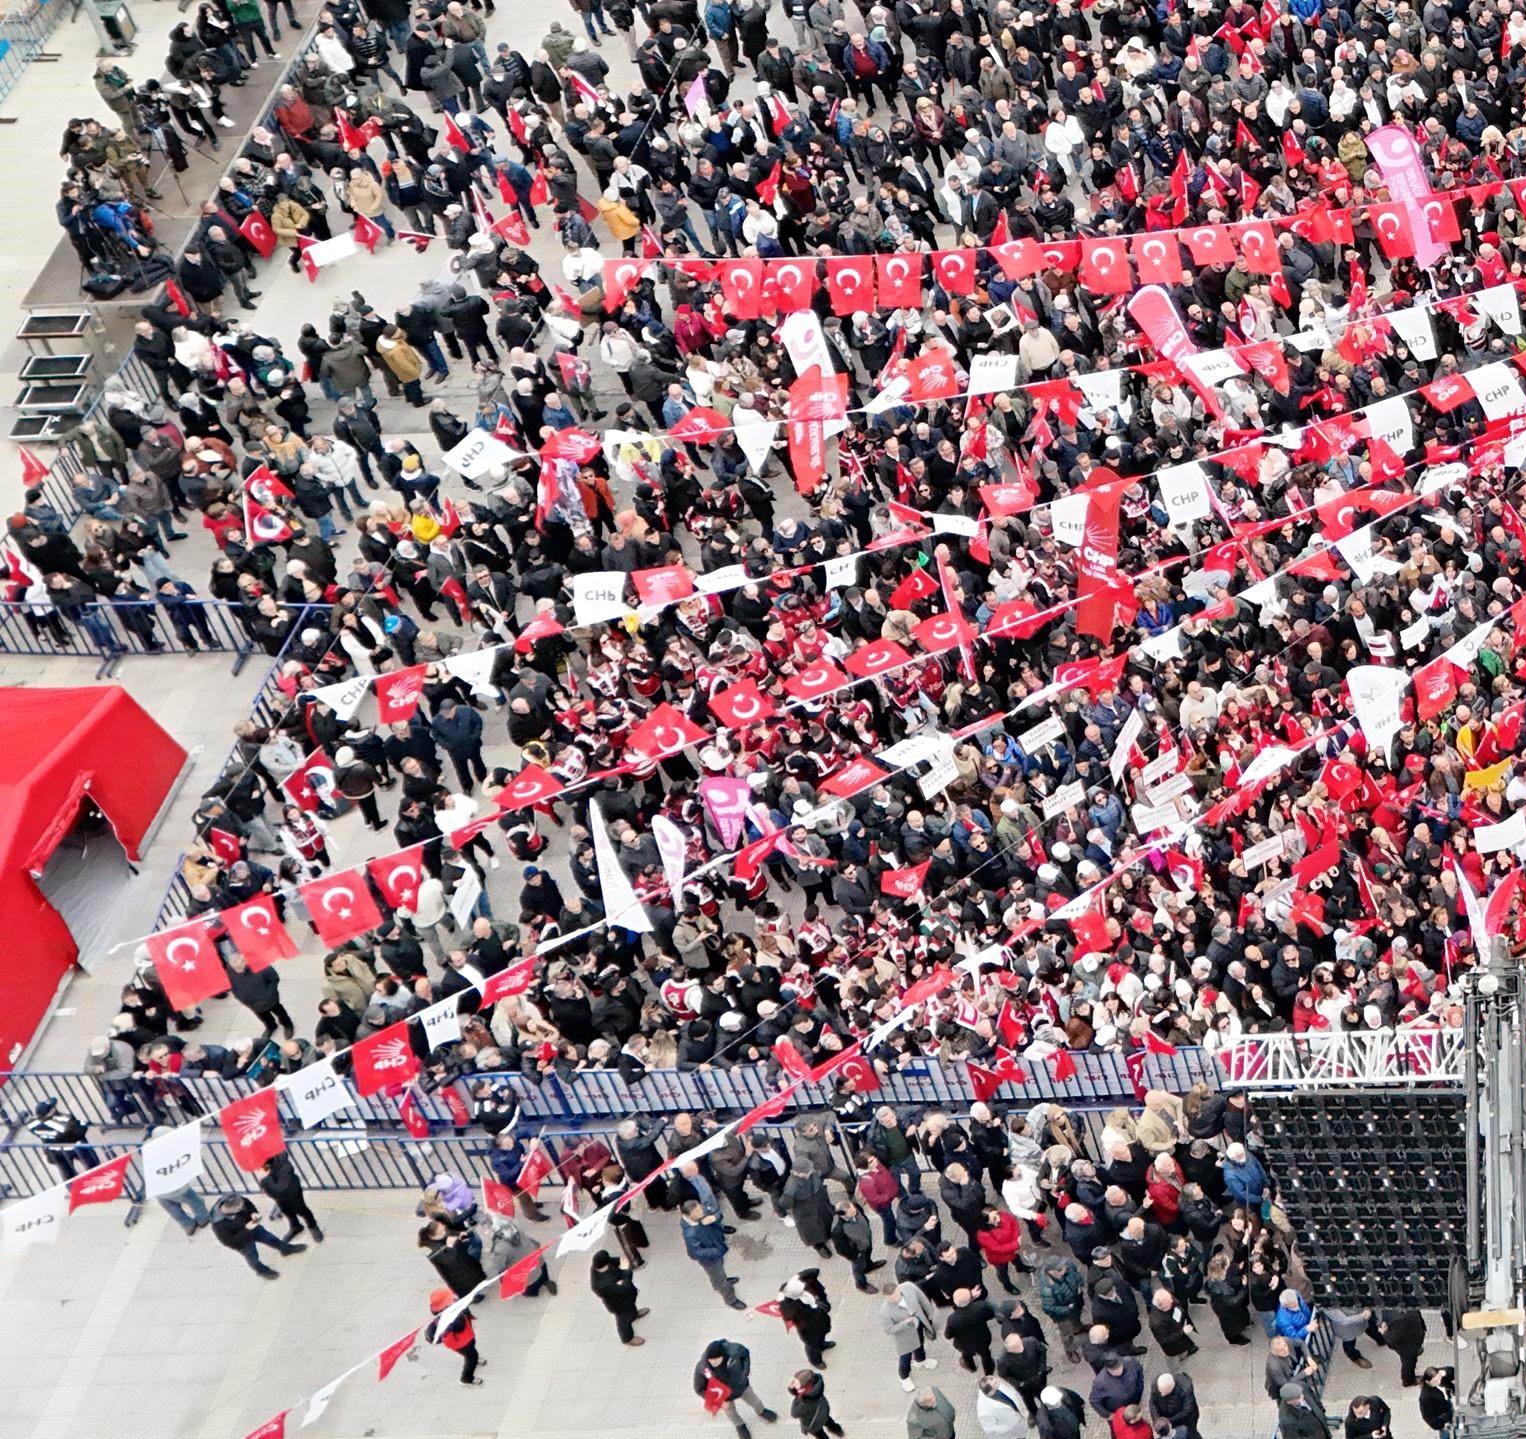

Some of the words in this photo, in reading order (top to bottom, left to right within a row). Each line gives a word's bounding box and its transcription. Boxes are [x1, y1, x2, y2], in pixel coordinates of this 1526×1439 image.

[1438, 384, 1460, 402] CHP
[1485, 385, 1509, 402] CHP
[1171, 491, 1199, 506] CHP
[1084, 547, 1115, 570] CHP
